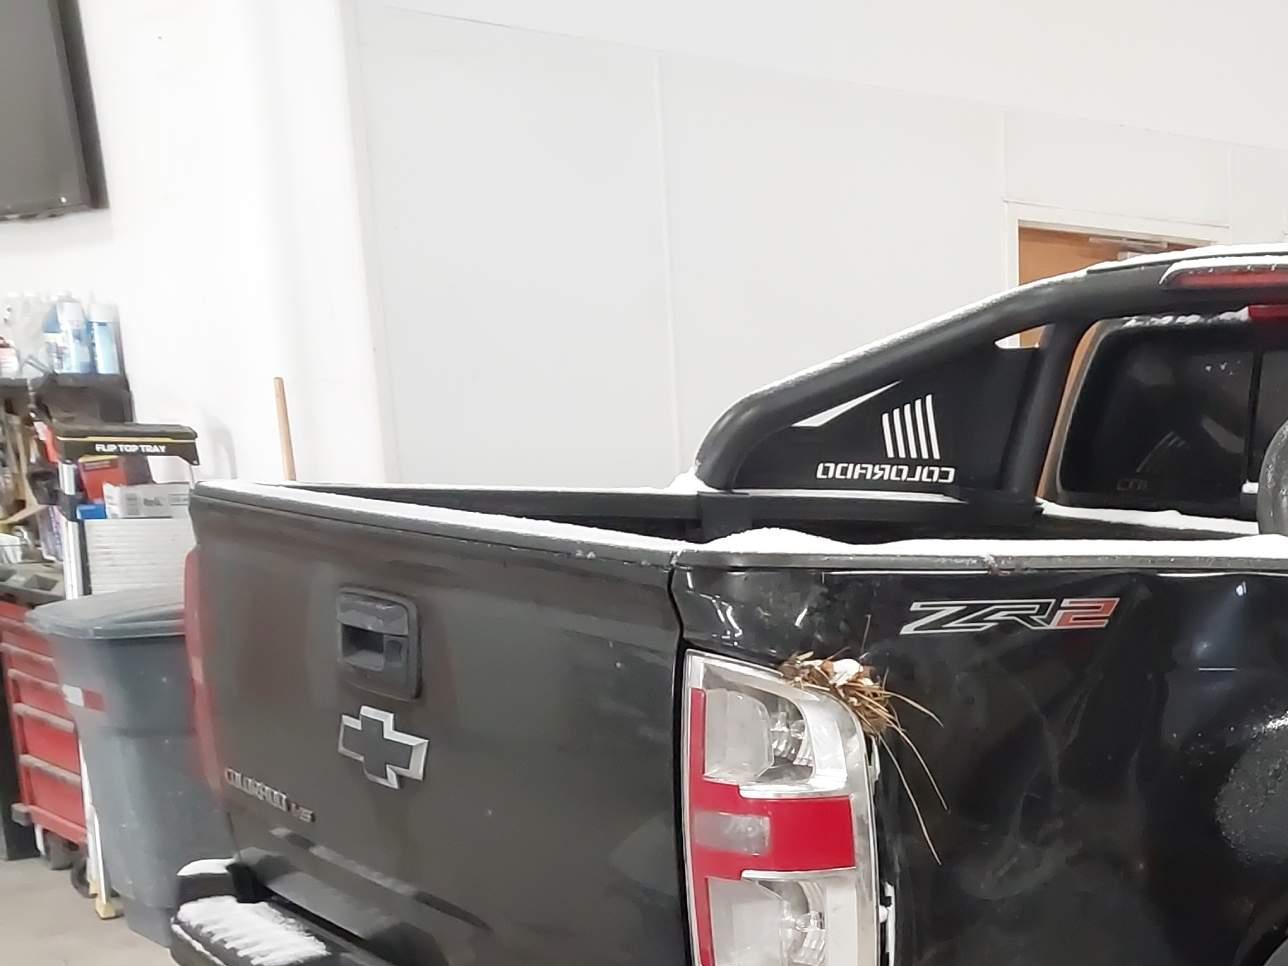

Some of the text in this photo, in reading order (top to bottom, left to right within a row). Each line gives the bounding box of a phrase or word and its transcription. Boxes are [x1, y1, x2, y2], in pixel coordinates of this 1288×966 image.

[95, 443, 167, 453] FLIP TOP TRAY
[899, 597, 1121, 636] ZR2
